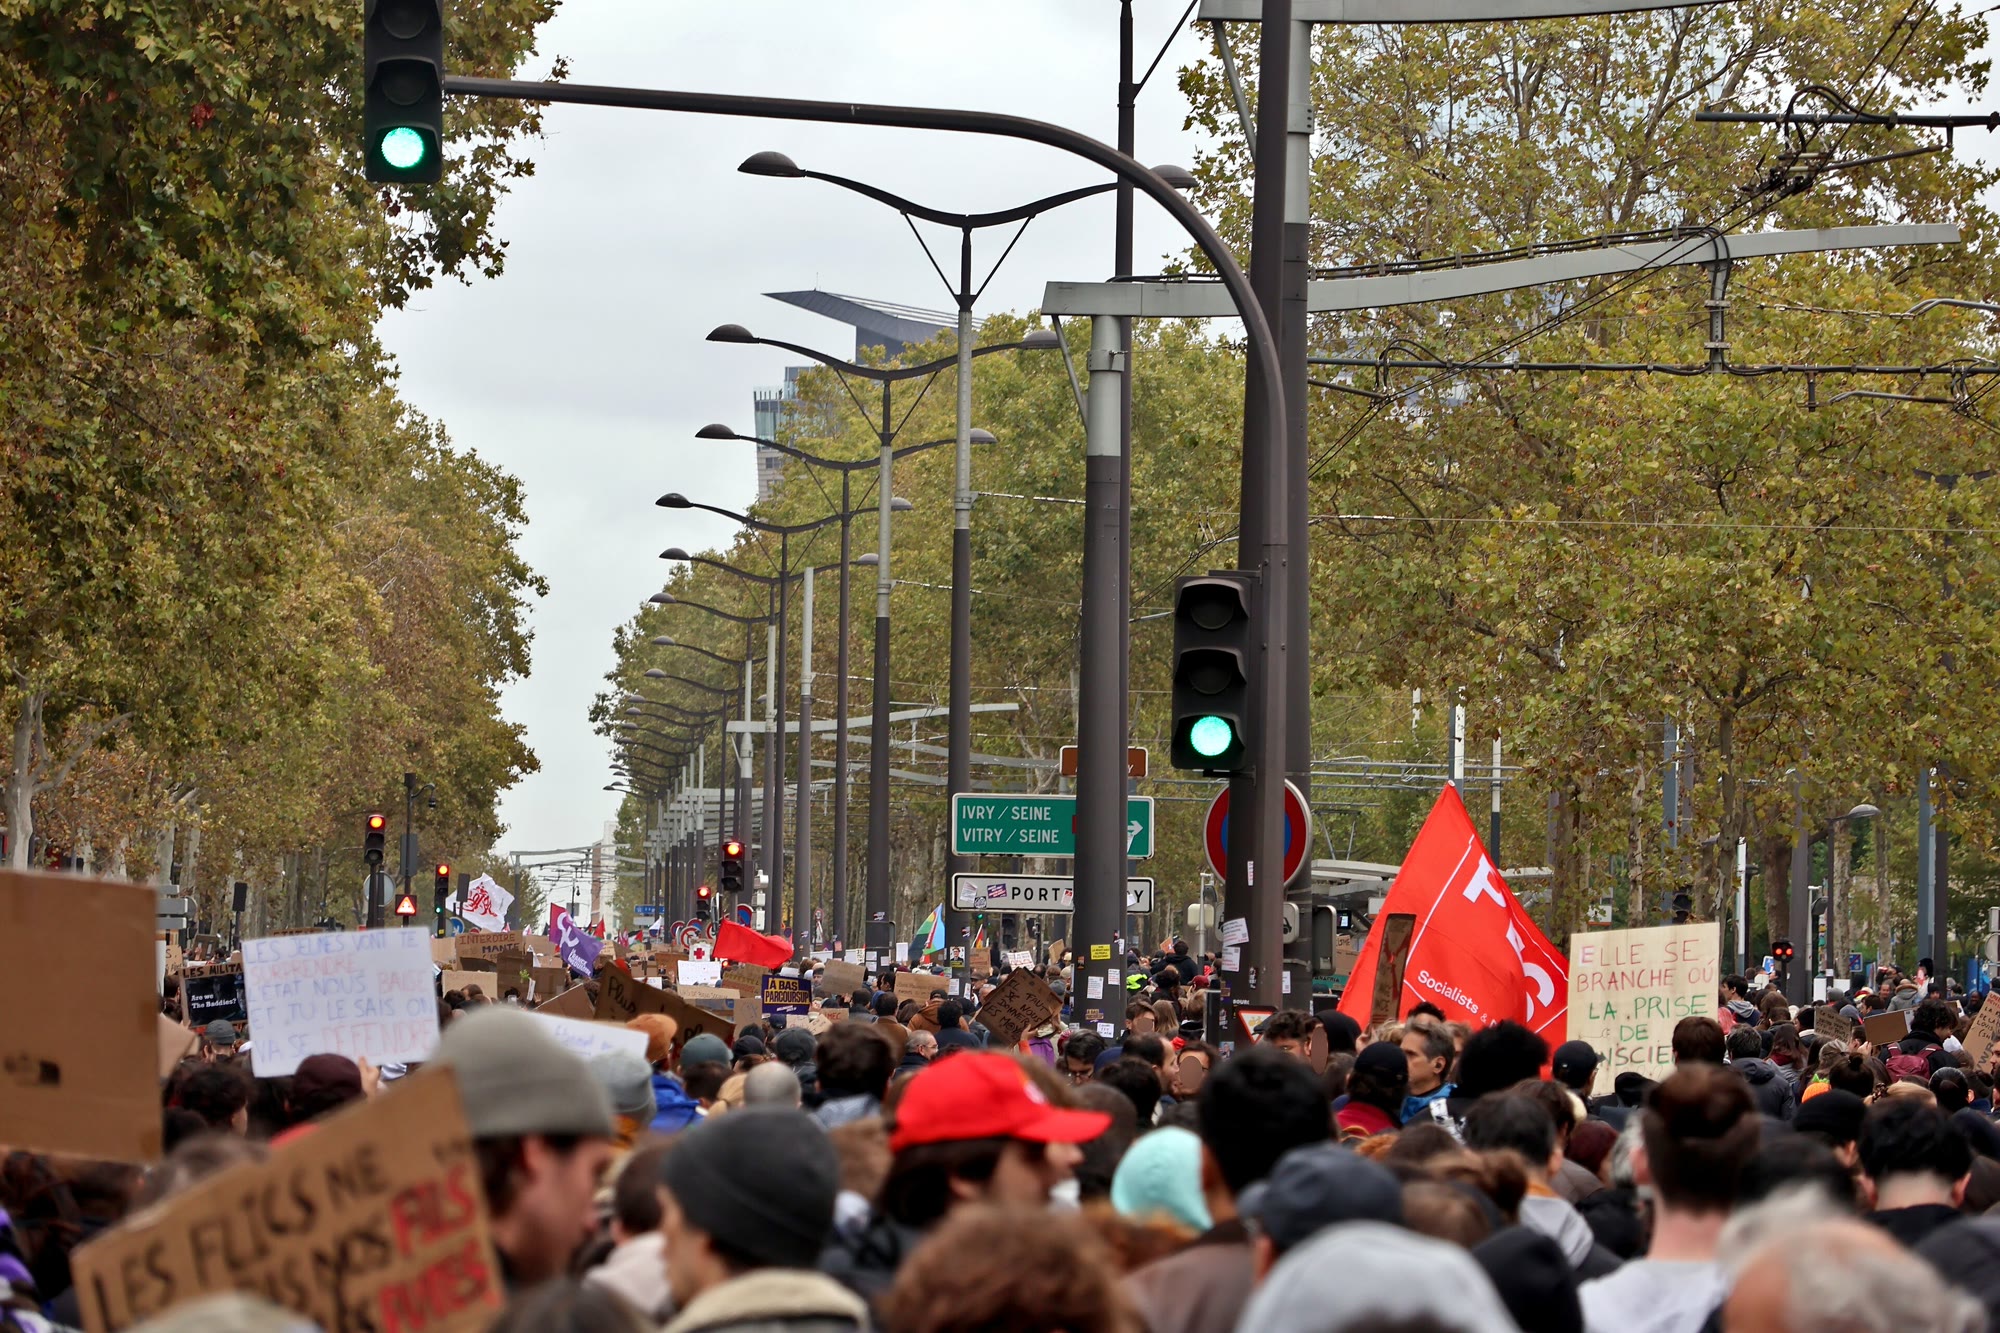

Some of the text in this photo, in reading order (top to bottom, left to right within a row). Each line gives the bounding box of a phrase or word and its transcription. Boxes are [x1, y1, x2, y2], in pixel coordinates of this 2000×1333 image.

[962, 806, 995, 820] IVRY
[1011, 806, 1051, 821] SEINE
[962, 828, 1003, 843] VITRY
[1018, 829, 1059, 844] SEINE
[1011, 886, 1073, 901] PORT
[459, 933, 516, 945] INTERDIRE
[1581, 939, 1700, 967] ELLE SE
[183, 967, 205, 979] LES
[209, 963, 243, 975] MILITA
[778, 980, 798, 991] BAS
[1577, 968, 1676, 993] BRANCHE
[765, 990, 809, 1003] PARCOURSUP
[1417, 970, 1479, 1014] Socialists
[1588, 994, 1708, 1021] LA PRISE
[1620, 1023, 1649, 1043] DE
[1600, 1044, 1676, 1067] NSCIE
